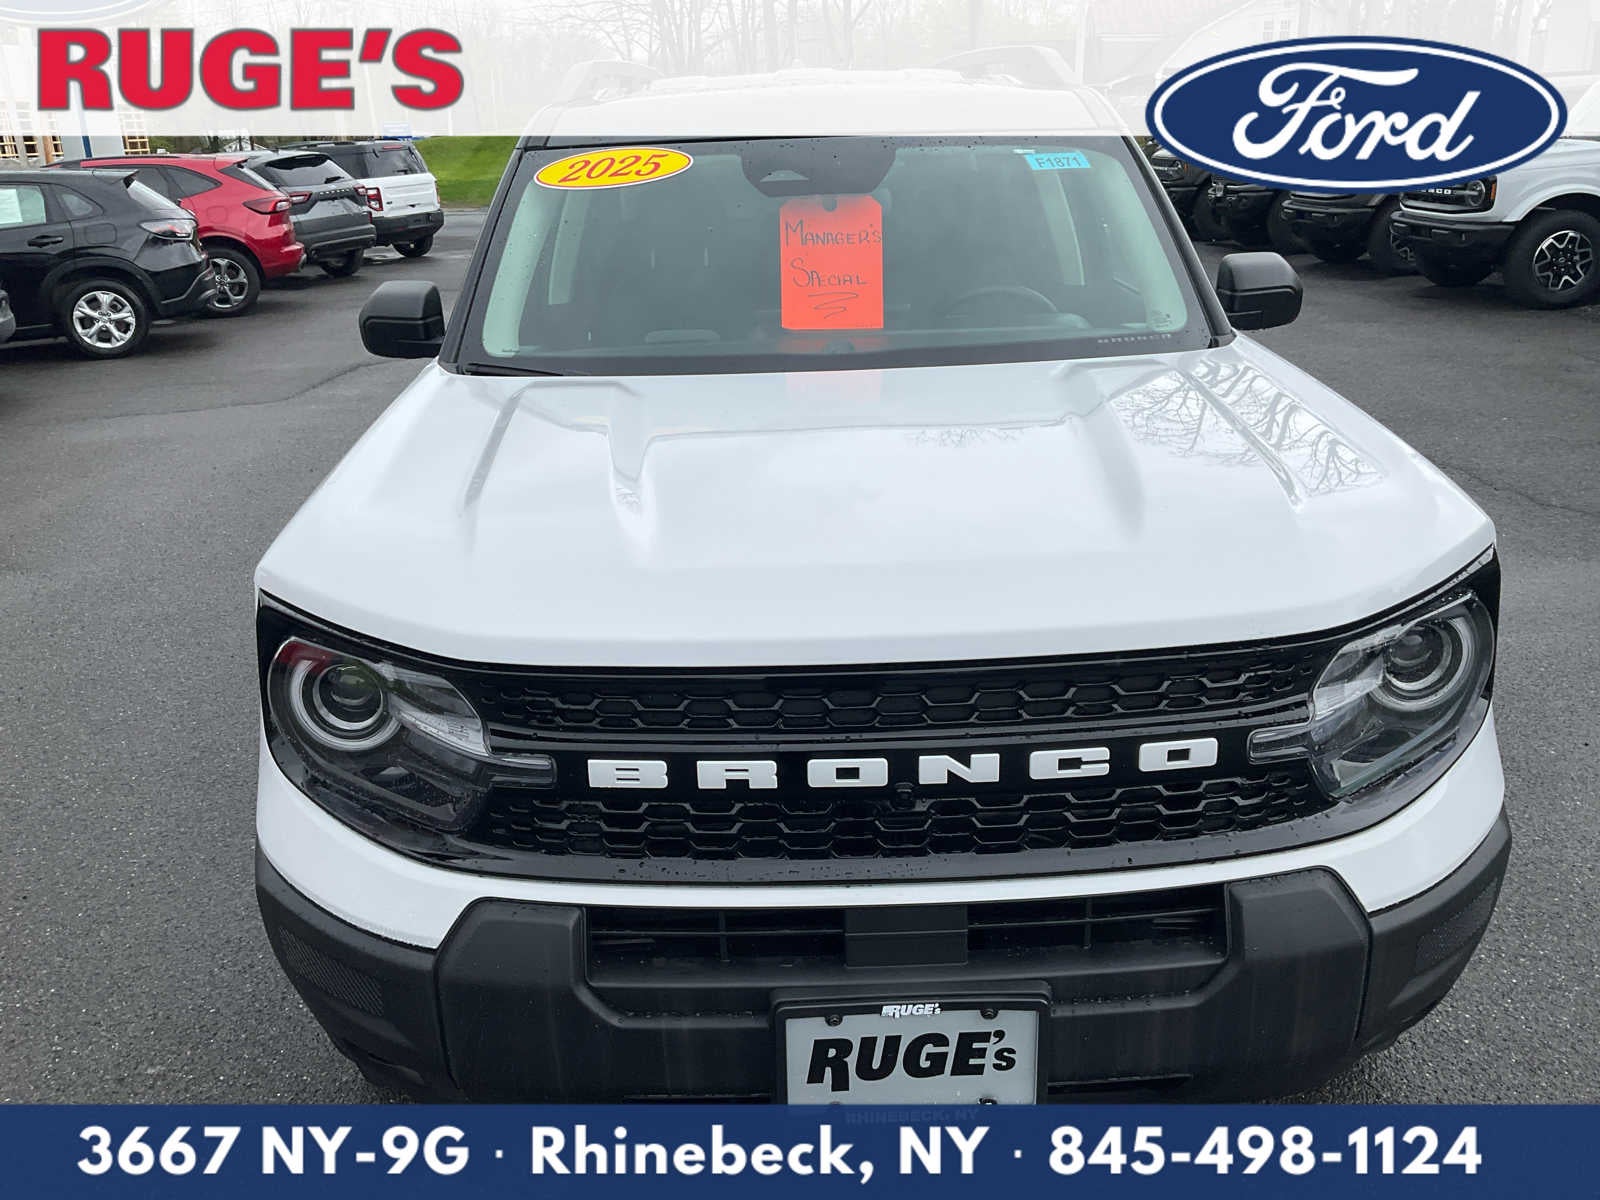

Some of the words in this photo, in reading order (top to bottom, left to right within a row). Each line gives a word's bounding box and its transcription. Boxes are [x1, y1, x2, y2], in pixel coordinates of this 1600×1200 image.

[558, 153, 669, 183] 2025
[587, 737, 1219, 789] BRONCO
[806, 1029, 1017, 1093] RUGE's
